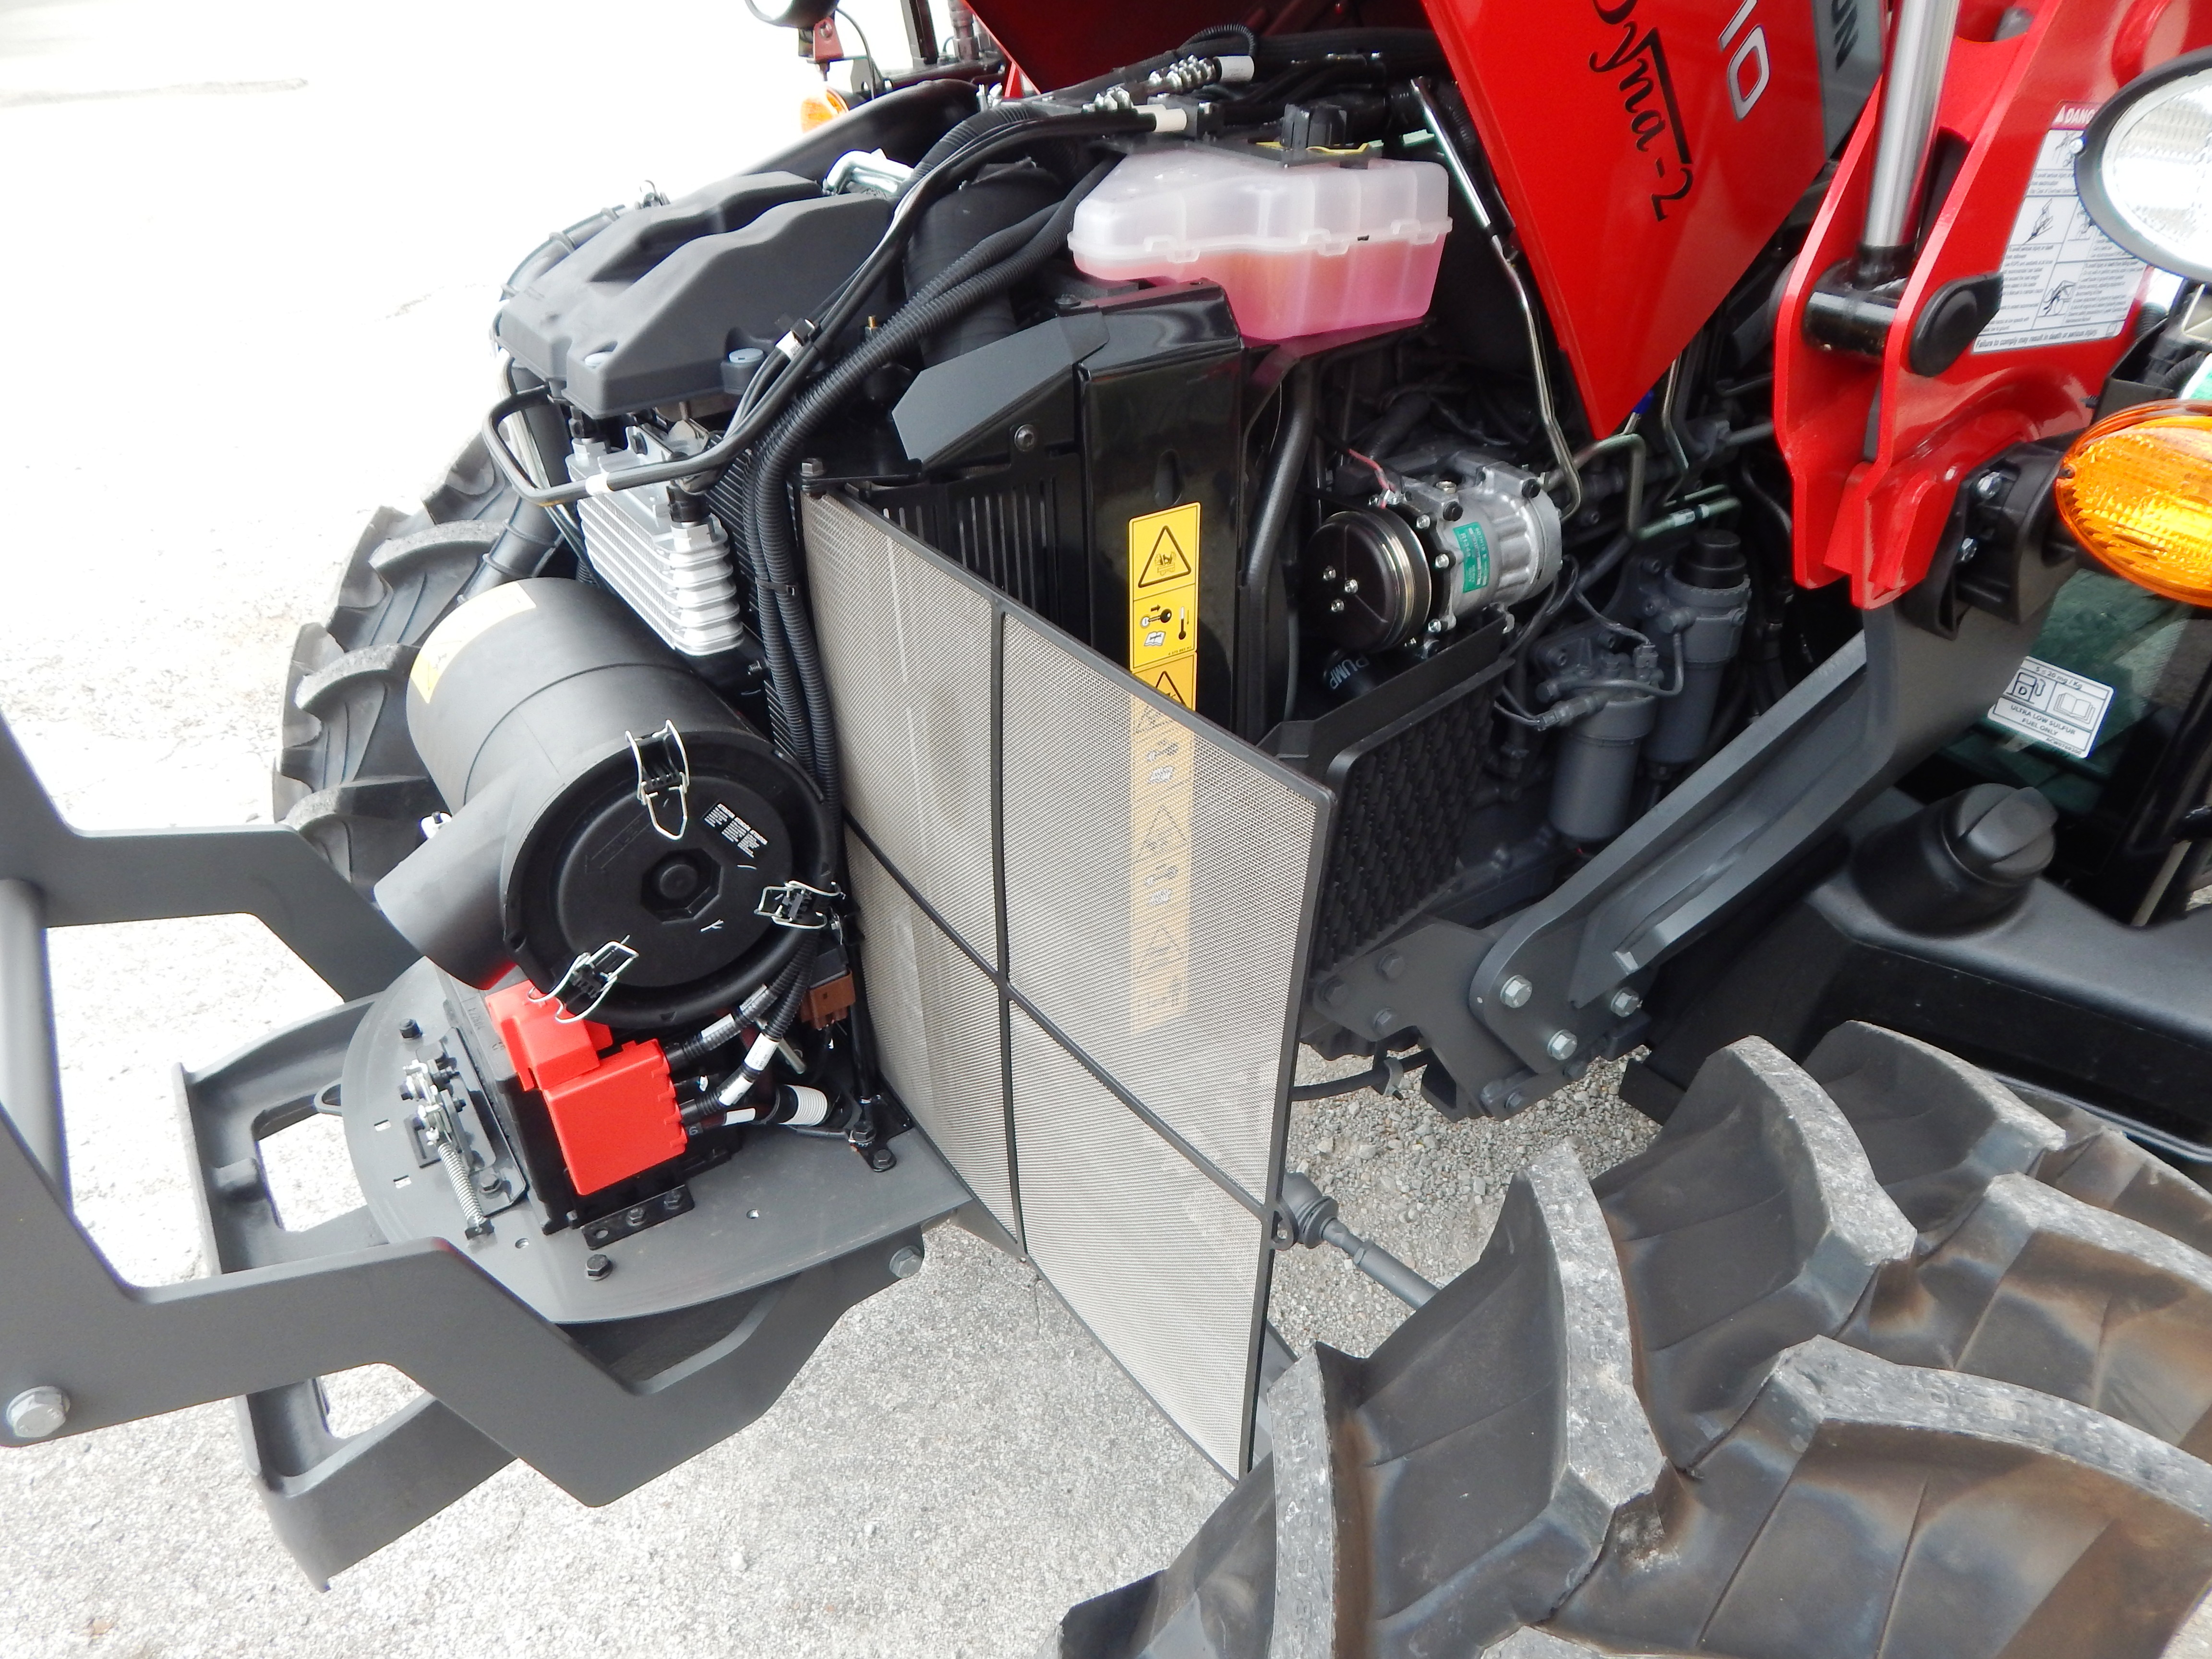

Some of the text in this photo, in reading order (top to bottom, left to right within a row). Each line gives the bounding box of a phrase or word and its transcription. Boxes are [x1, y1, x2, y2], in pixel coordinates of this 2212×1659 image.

[2065, 107, 2096, 122] DANG
[1977, 338, 1994, 348] Failure
[1330, 656, 1370, 690] PUMP
[2018, 686, 2028, 696] D
[2010, 704, 2077, 735] ULTRA LOW SULFUR
[2021, 718, 2059, 736] FUEL ONLY
[688, 1126, 698, 1136] 6
